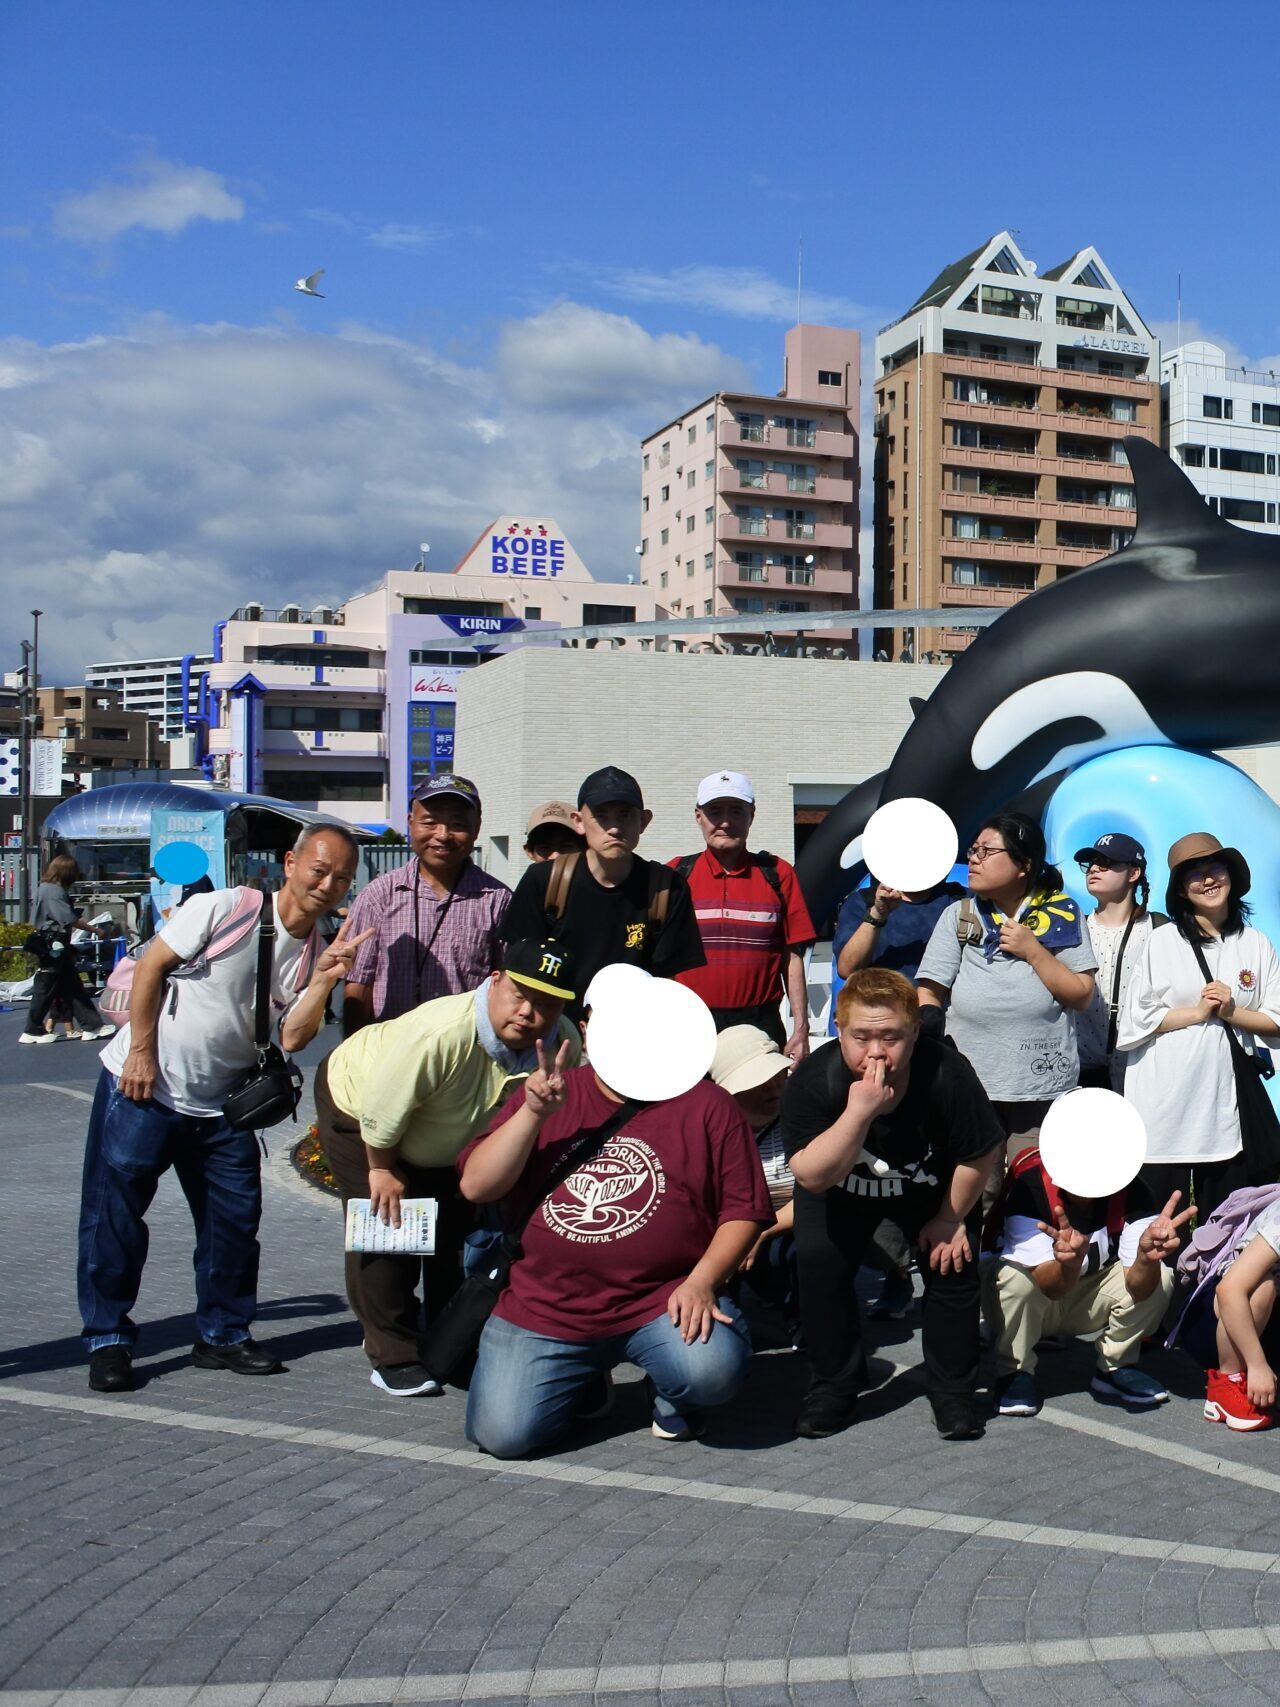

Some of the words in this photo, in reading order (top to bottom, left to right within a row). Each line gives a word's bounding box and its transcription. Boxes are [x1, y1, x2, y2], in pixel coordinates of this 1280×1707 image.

[1089, 335, 1149, 355] LAUREL
[492, 535, 565, 557] KOBE
[492, 555, 565, 577] BEEF
[459, 617, 501, 630] KIRIN
[436, 734, 453, 744] 神戸
[46, 745, 55, 765] KOBE
[167, 815, 204, 832] ORCA
[1097, 834, 1114, 846] NY
[1034, 1042, 1049, 1050] THE
[583, 1163, 626, 1174] MALIBU
[616, 1135, 656, 1158] THROUGHOUT
[651, 1157, 663, 1172] THE
[657, 1172, 666, 1194] WORLD
[566, 1176, 596, 1199] BLUE
[600, 1176, 637, 1201] OCEAN
[836, 1173, 904, 1197] MA
[551, 1224, 566, 1237] ARE
[566, 1231, 613, 1244] BEAUTIFUL
[615, 1217, 649, 1240] ANIMALS
